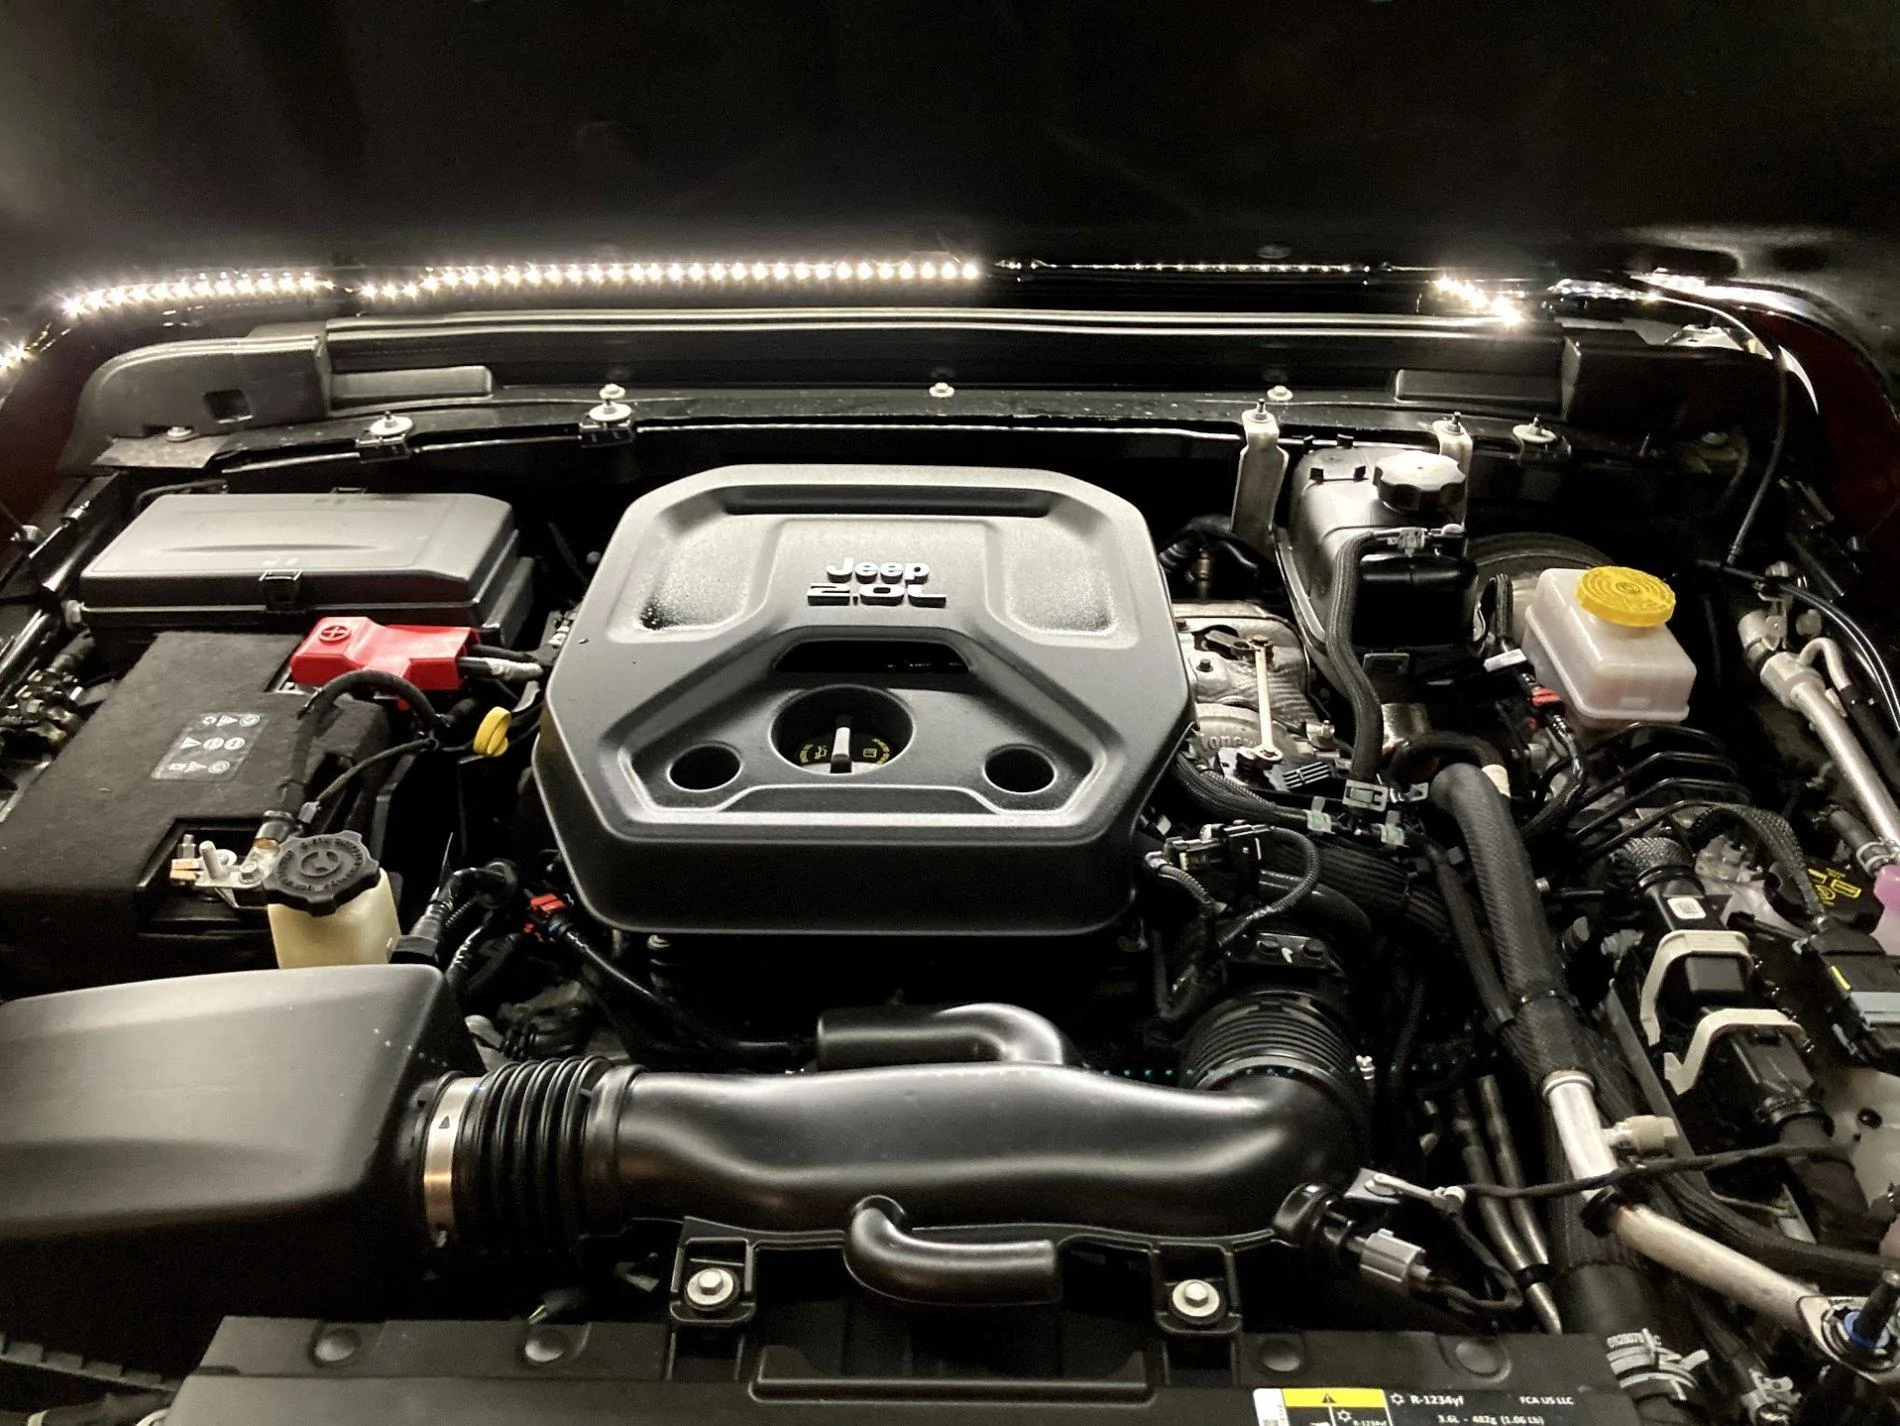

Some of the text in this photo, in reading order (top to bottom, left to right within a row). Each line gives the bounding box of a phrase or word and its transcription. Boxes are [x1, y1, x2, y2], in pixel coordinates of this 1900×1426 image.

[826, 557, 931, 584] Jeep
[806, 583, 948, 607] 2.0L
[1409, 1394, 1464, 1406] R-1234yf
[1519, 1396, 1575, 1405] FCA US LLC
